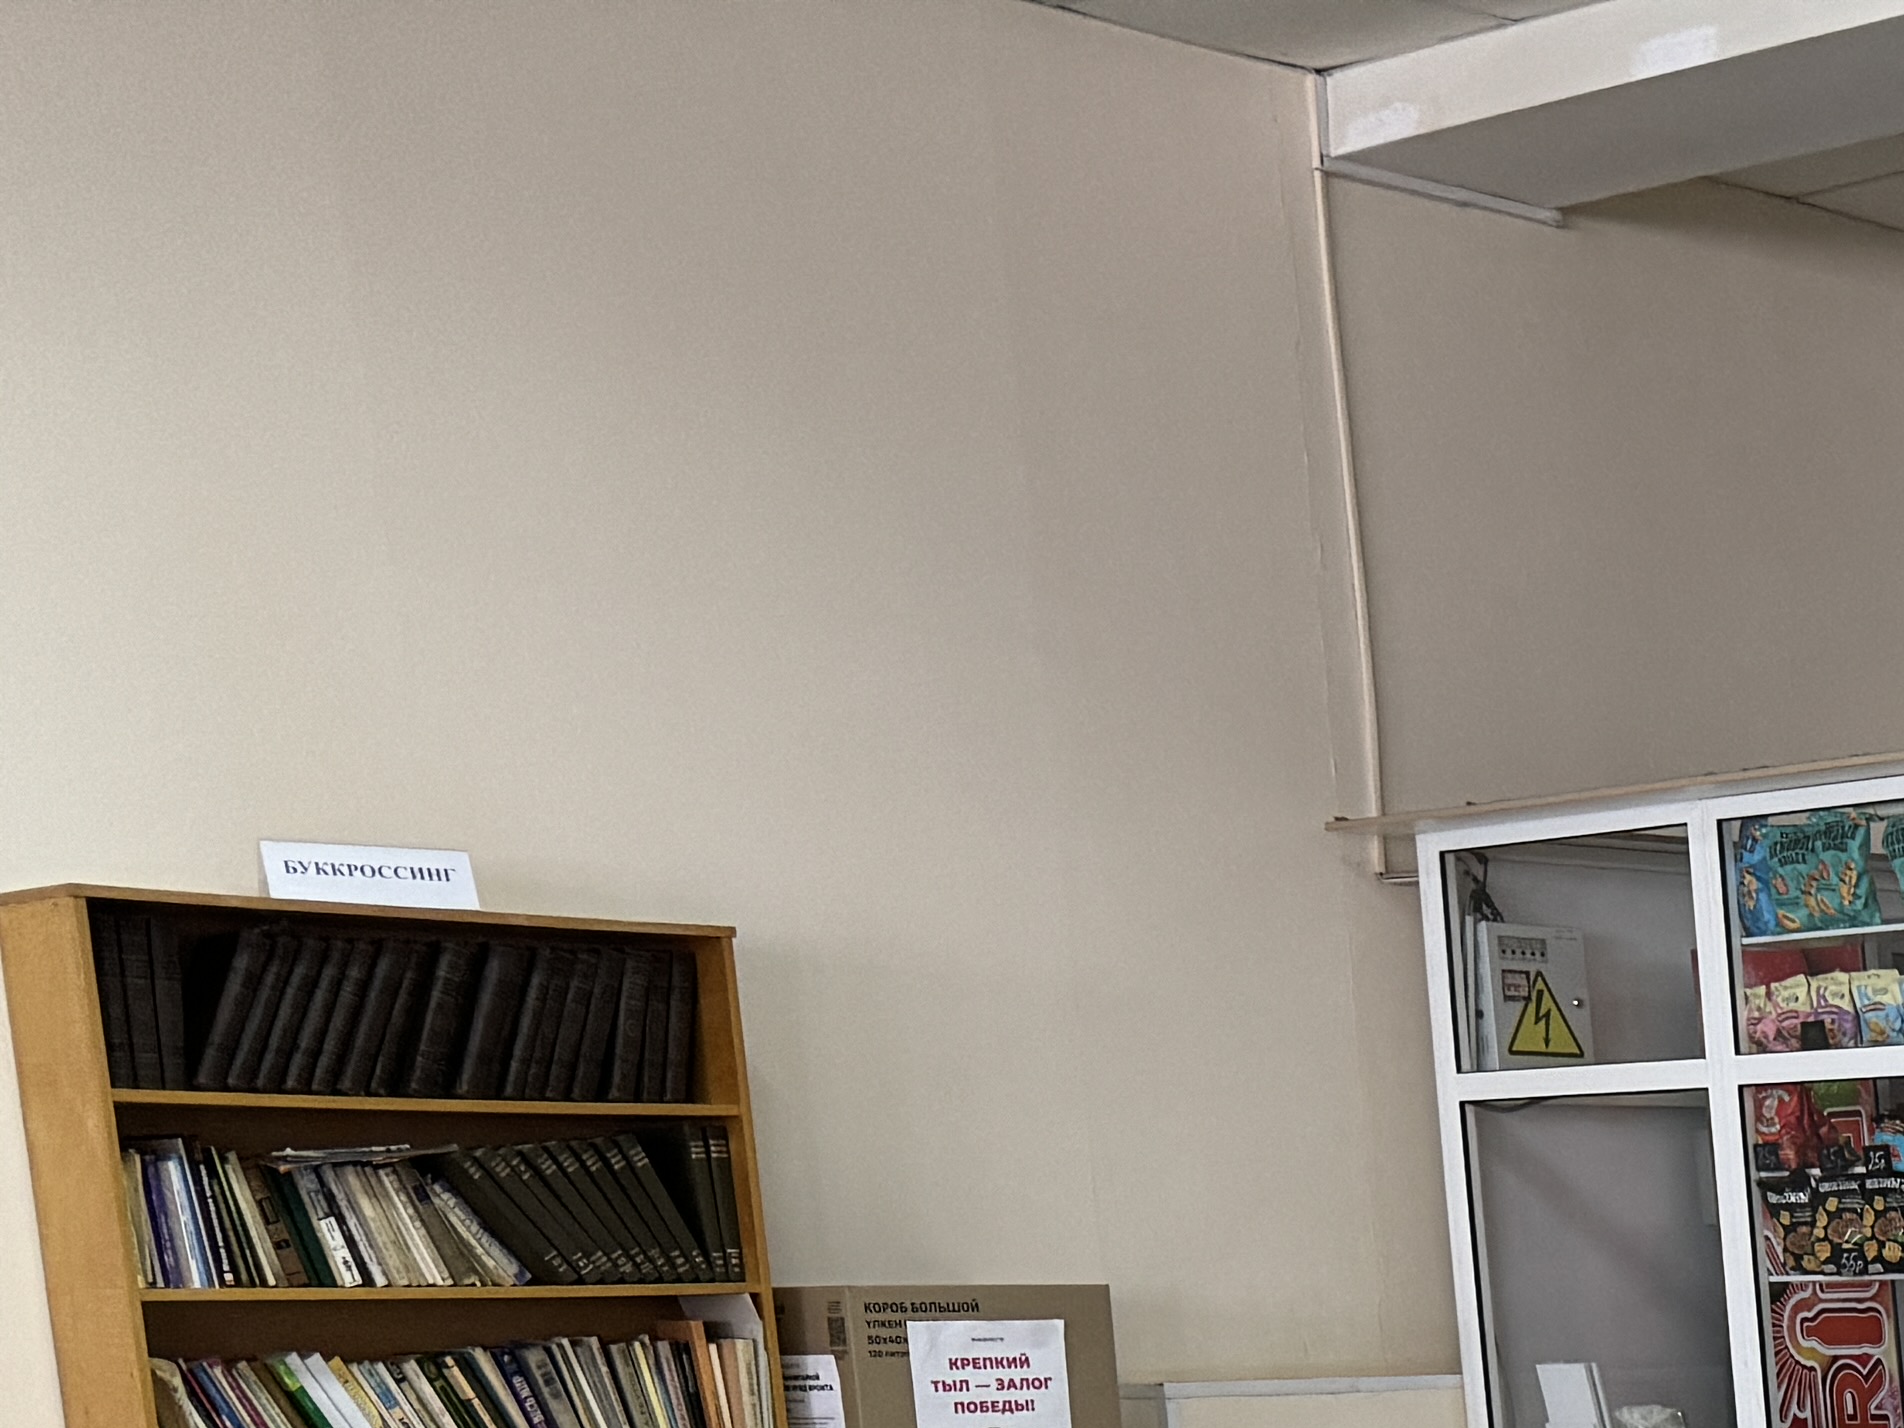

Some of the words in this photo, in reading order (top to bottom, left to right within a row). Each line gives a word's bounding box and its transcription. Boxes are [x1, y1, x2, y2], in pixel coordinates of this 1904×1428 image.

[283, 860, 456, 883] БУККРОССИНГ
[864, 1302, 907, 1313] КОРОБ
[910, 1299, 980, 1313] БОЛЬШОЙ
[948, 1353, 1031, 1371] КРЕПКИЙ
[931, 1379, 970, 1393] ТЫЛ
[995, 1377, 1053, 1391] ЗАЛОГ
[953, 1399, 1036, 1415] ПОБЕДЫ!
